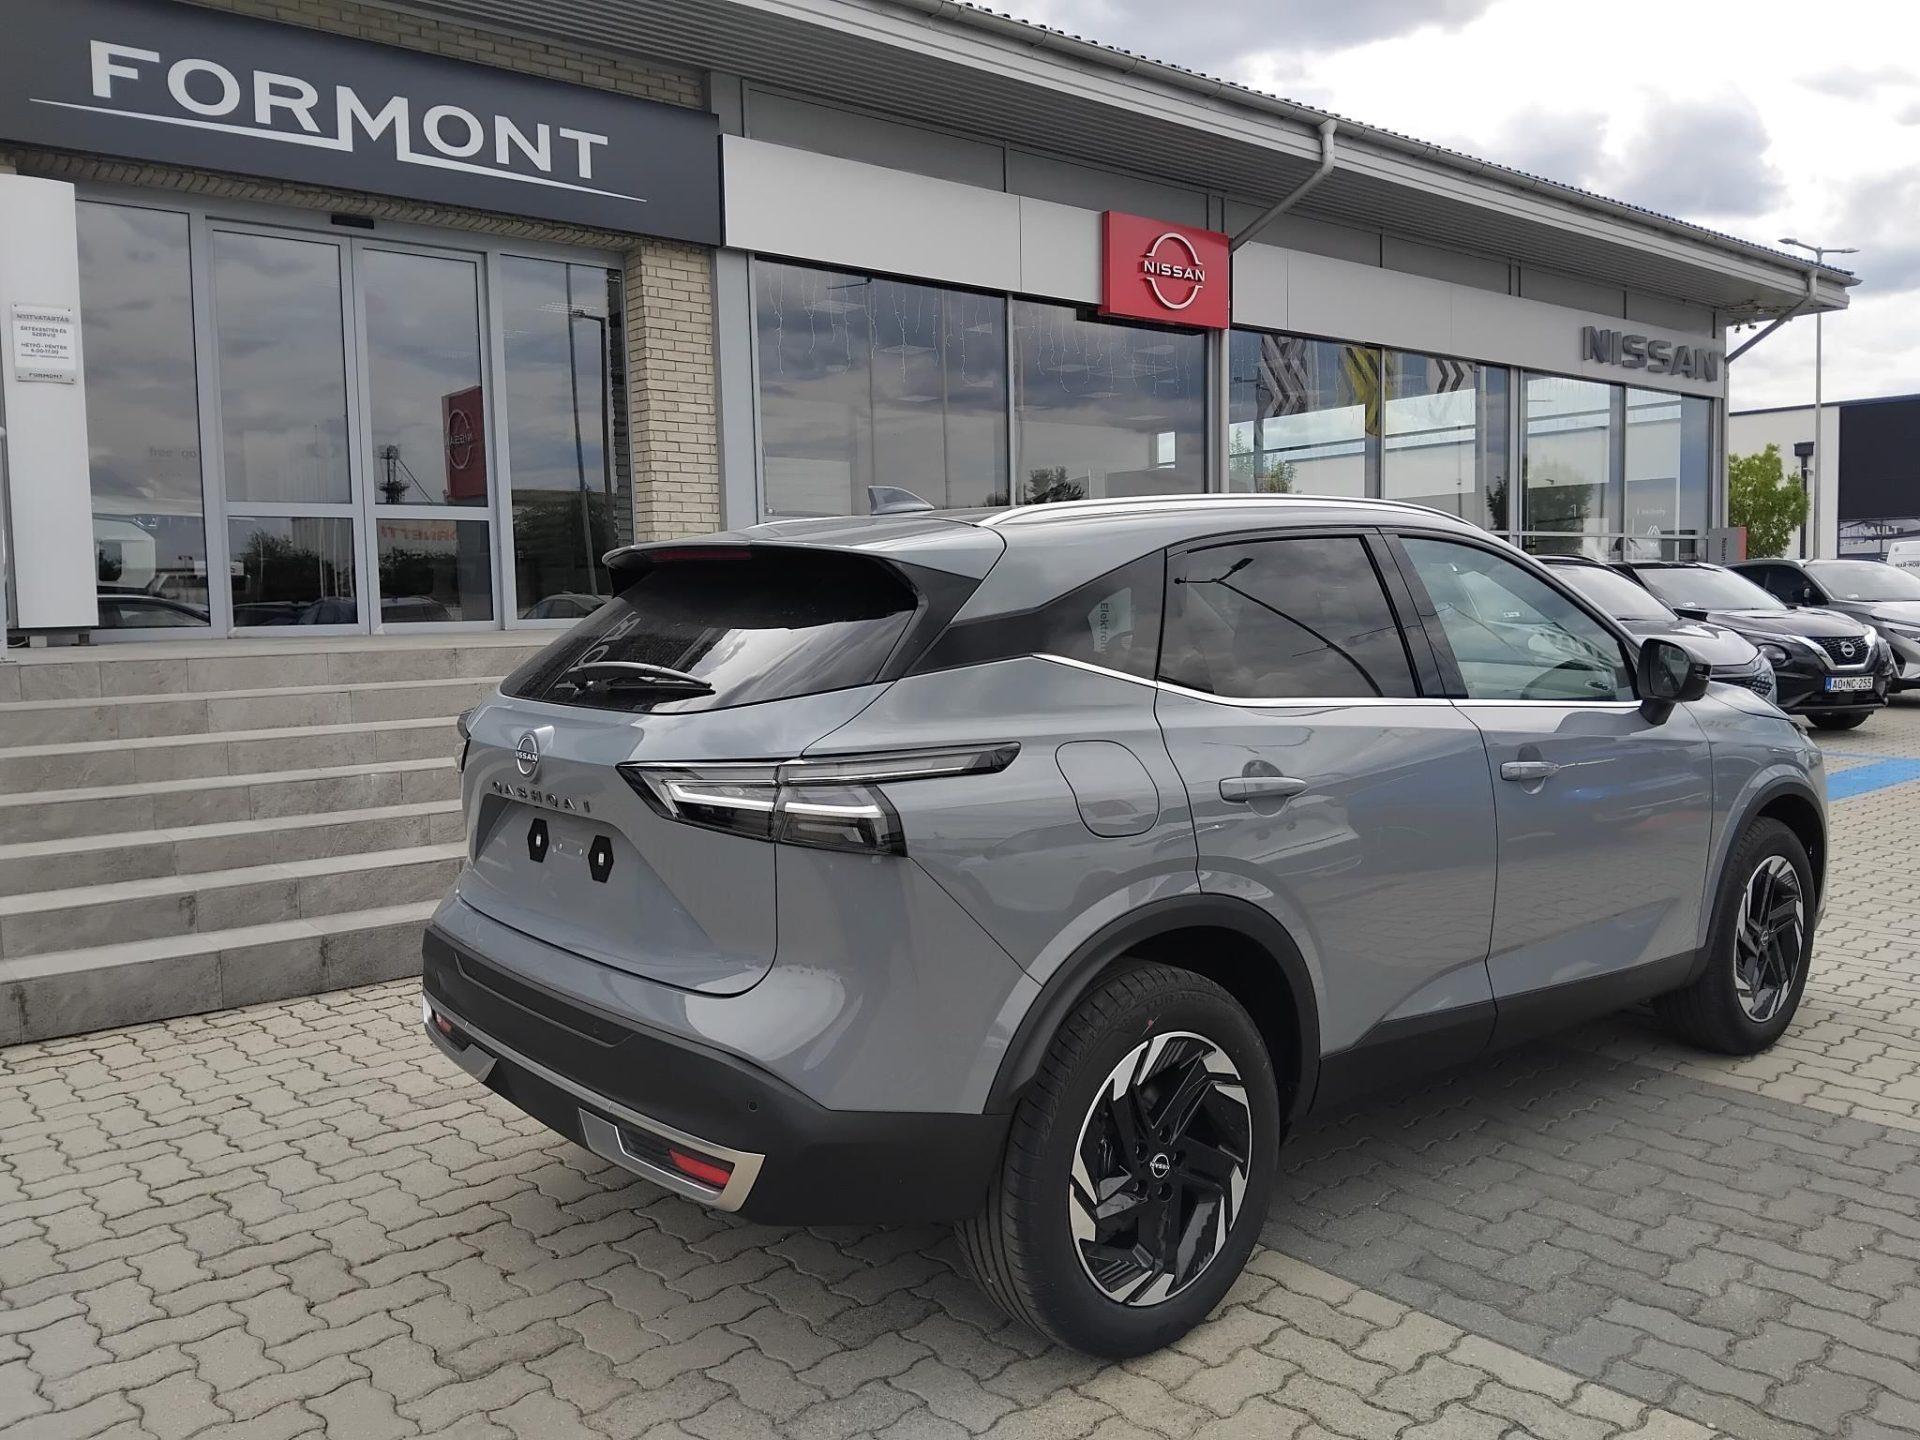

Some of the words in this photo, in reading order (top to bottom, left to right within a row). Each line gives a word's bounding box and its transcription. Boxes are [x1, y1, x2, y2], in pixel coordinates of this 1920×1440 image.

[90, 40, 608, 179] FORMONT
[1144, 260, 1205, 282] NISSAN
[1582, 326, 1721, 382] NISSAN
[492, 780, 591, 814] QASHQAI
